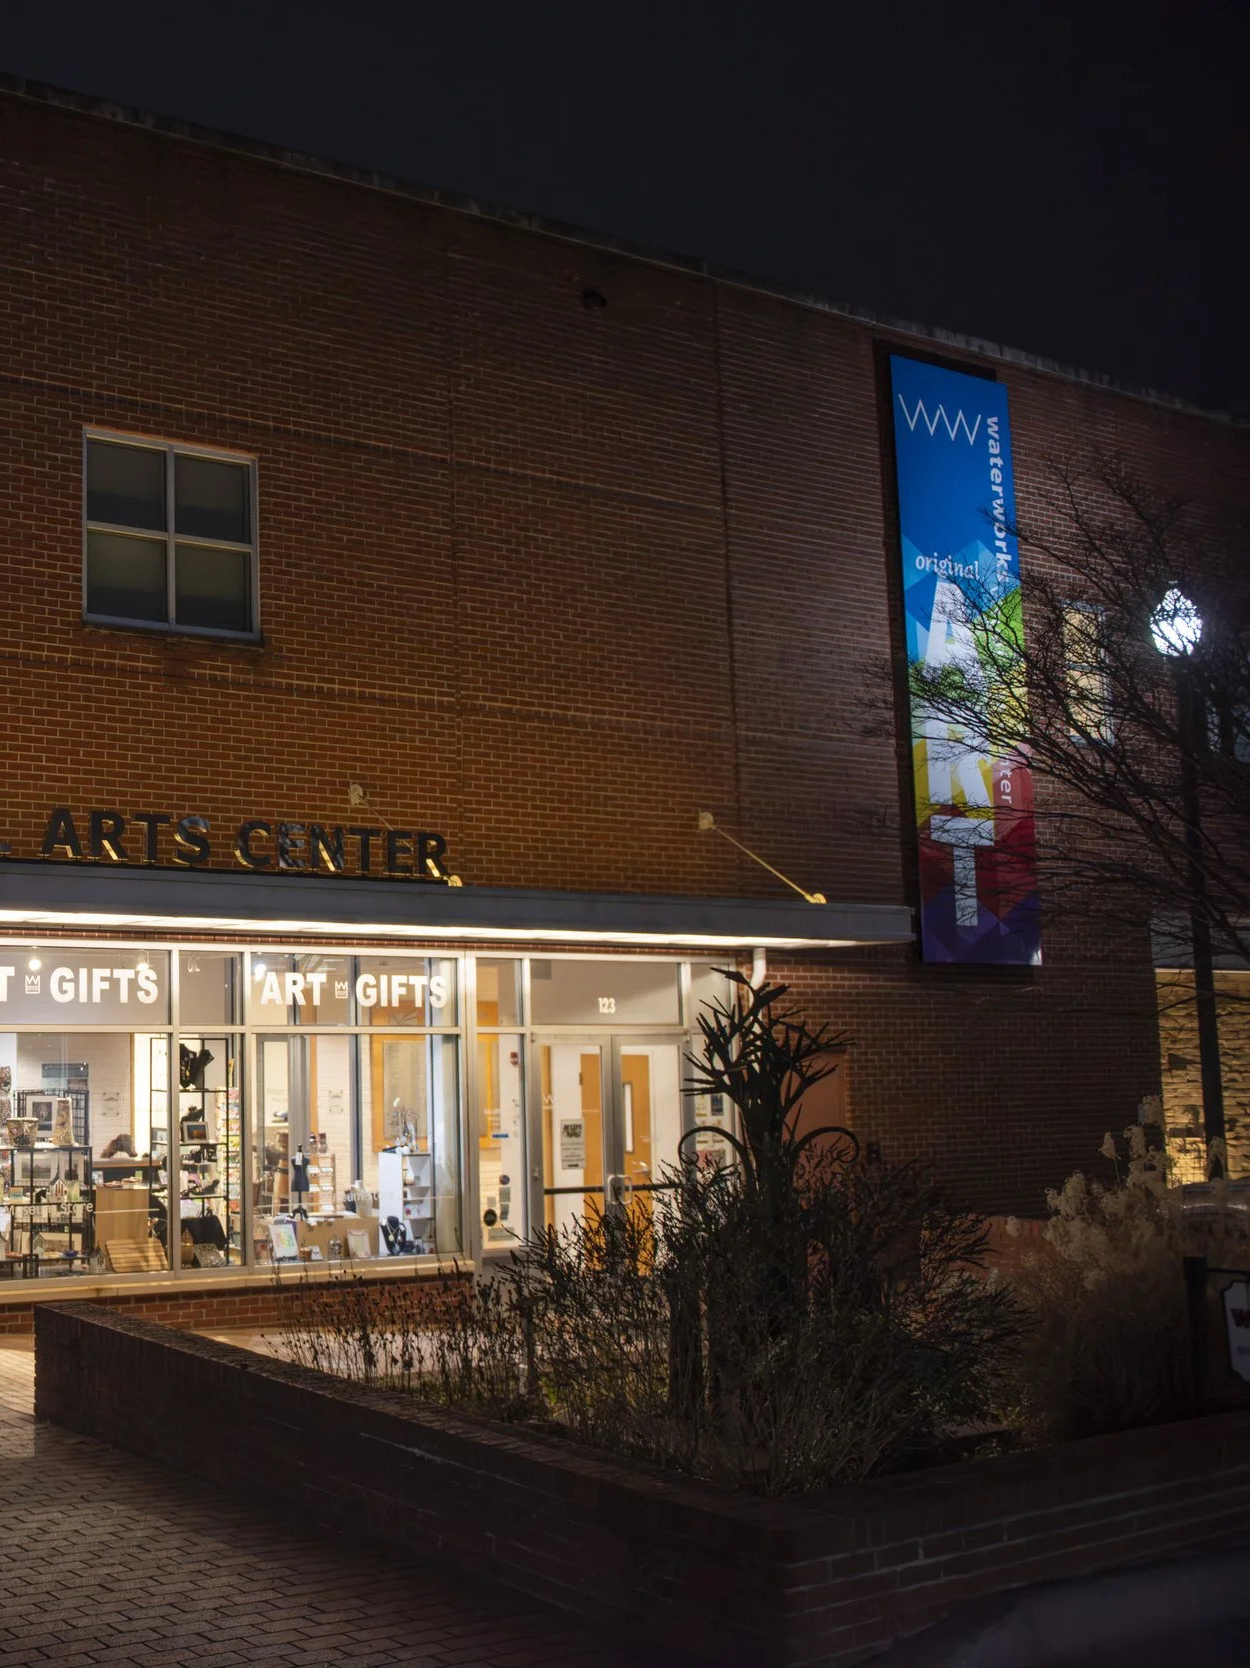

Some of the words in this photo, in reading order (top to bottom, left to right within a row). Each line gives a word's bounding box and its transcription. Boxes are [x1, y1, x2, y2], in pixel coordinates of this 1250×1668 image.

[986, 416, 1013, 583] waterworks
[915, 552, 980, 580] original
[38, 808, 212, 866] ARTS
[234, 820, 450, 878] CENTER
[50, 967, 158, 1004] GIFTS
[260, 972, 328, 1006] ART
[355, 973, 447, 1008] GIFTS
[598, 997, 616, 1013] 123
